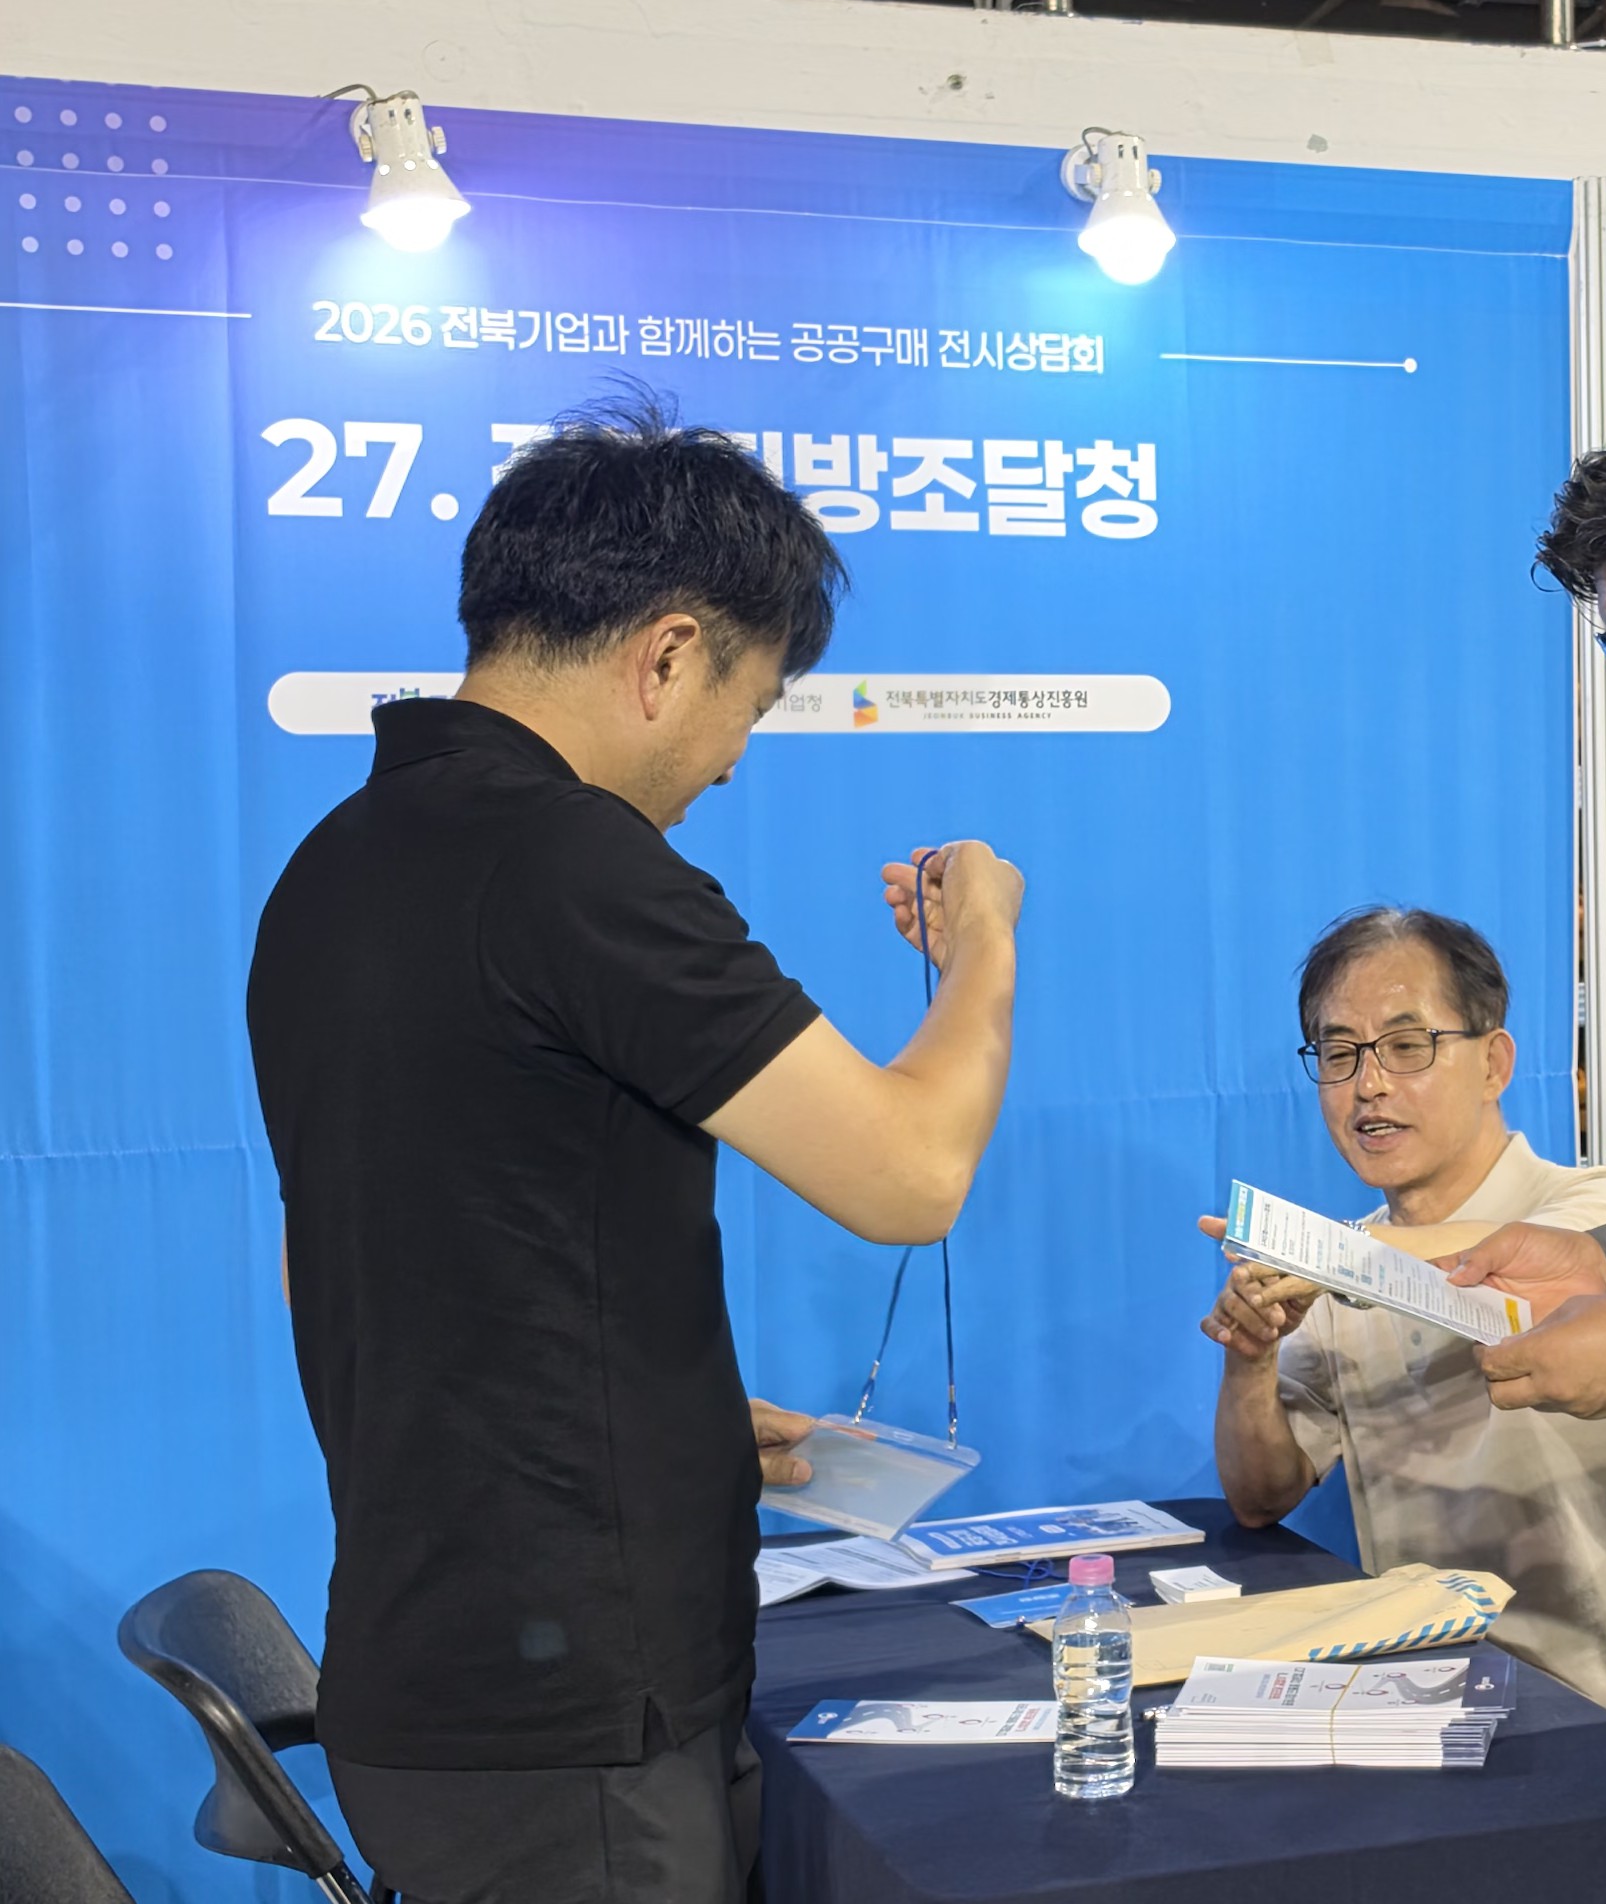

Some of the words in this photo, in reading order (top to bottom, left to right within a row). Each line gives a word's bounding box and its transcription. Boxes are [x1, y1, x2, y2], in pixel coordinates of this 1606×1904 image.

[313, 300, 432, 345] 2026
[438, 305, 629, 355] 전북기업과
[638, 314, 781, 361] 함께하는
[791, 322, 929, 368] 공공구매
[939, 329, 1105, 374] 전시상담회
[260, 418, 459, 521] 27.
[491, 422, 1159, 539] 방조달청
[886, 689, 1089, 709] 전북특별자치도경제통상진흥원
